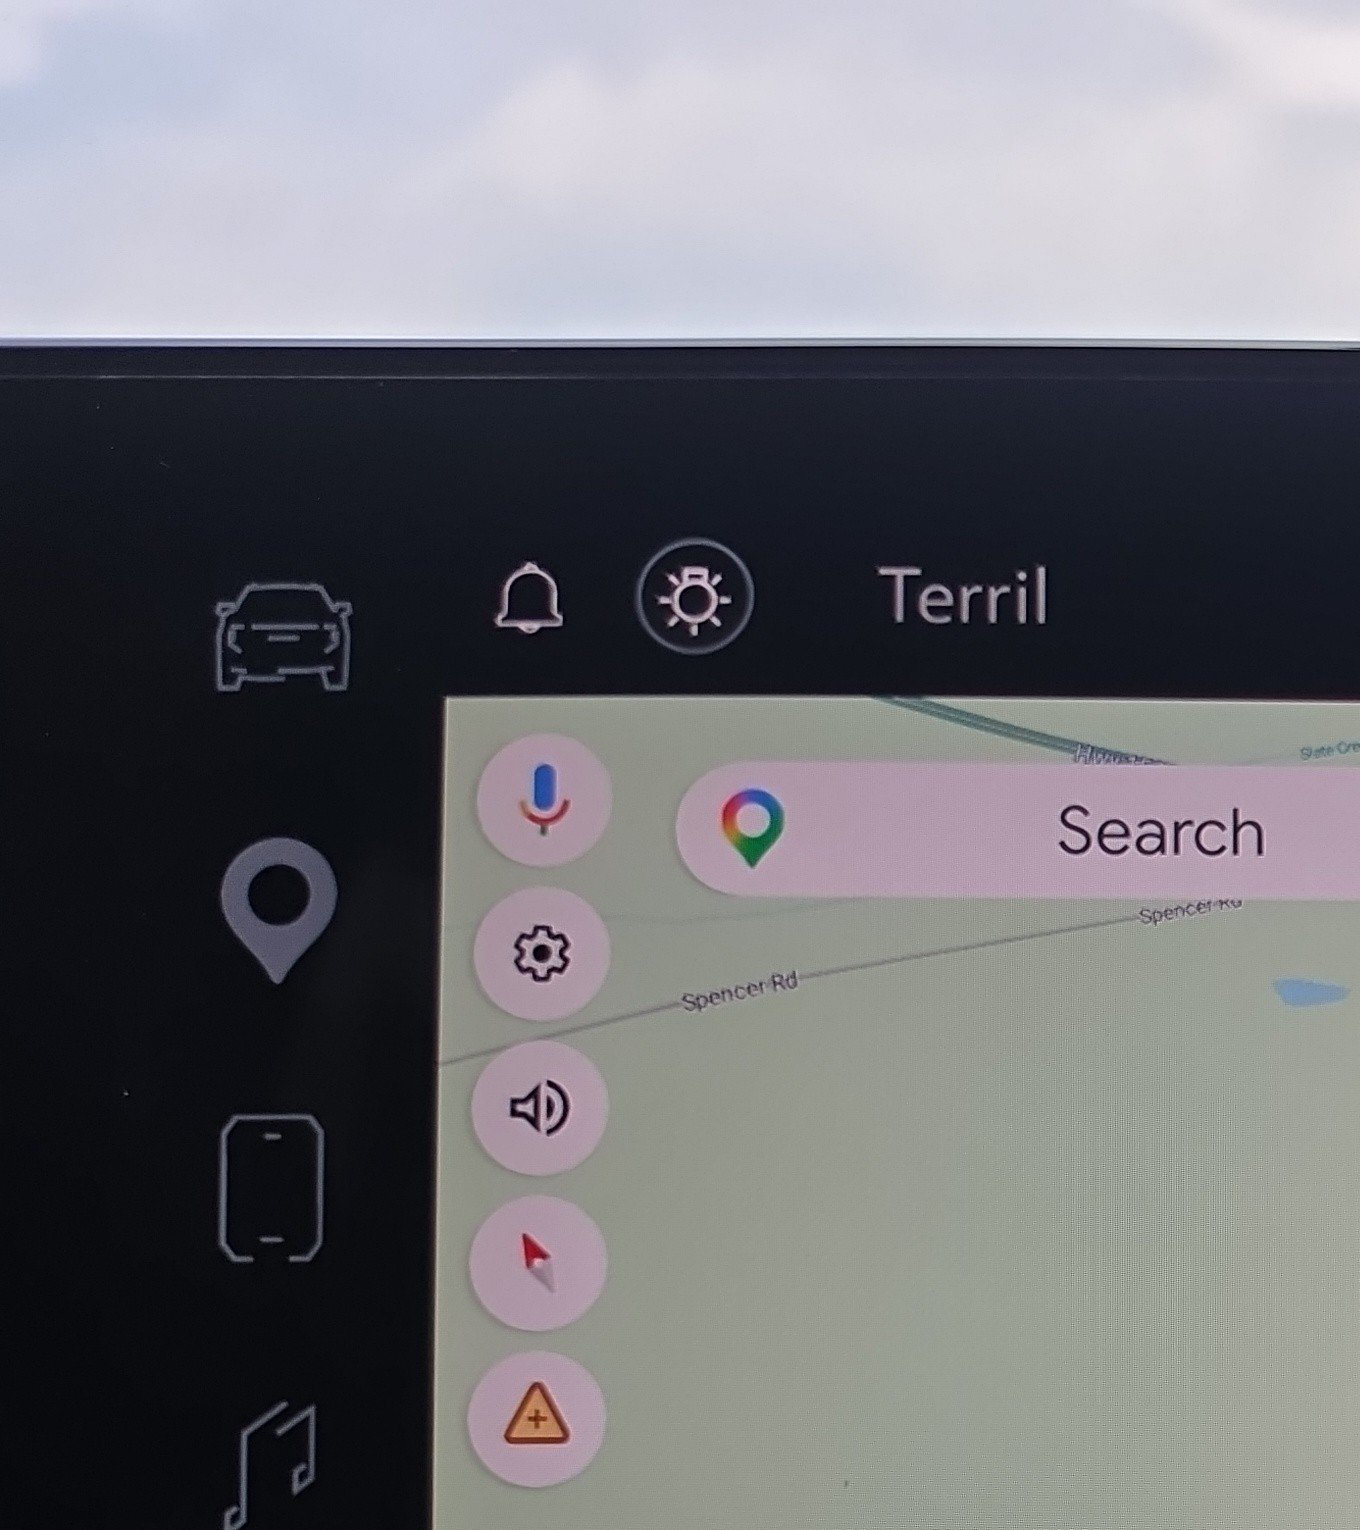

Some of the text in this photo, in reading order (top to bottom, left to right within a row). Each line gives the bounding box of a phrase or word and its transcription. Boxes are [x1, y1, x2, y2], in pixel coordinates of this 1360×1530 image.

[877, 565, 1047, 625] Terril
[1057, 804, 1265, 857] Search
[681, 970, 799, 1013] Spencer Rd
